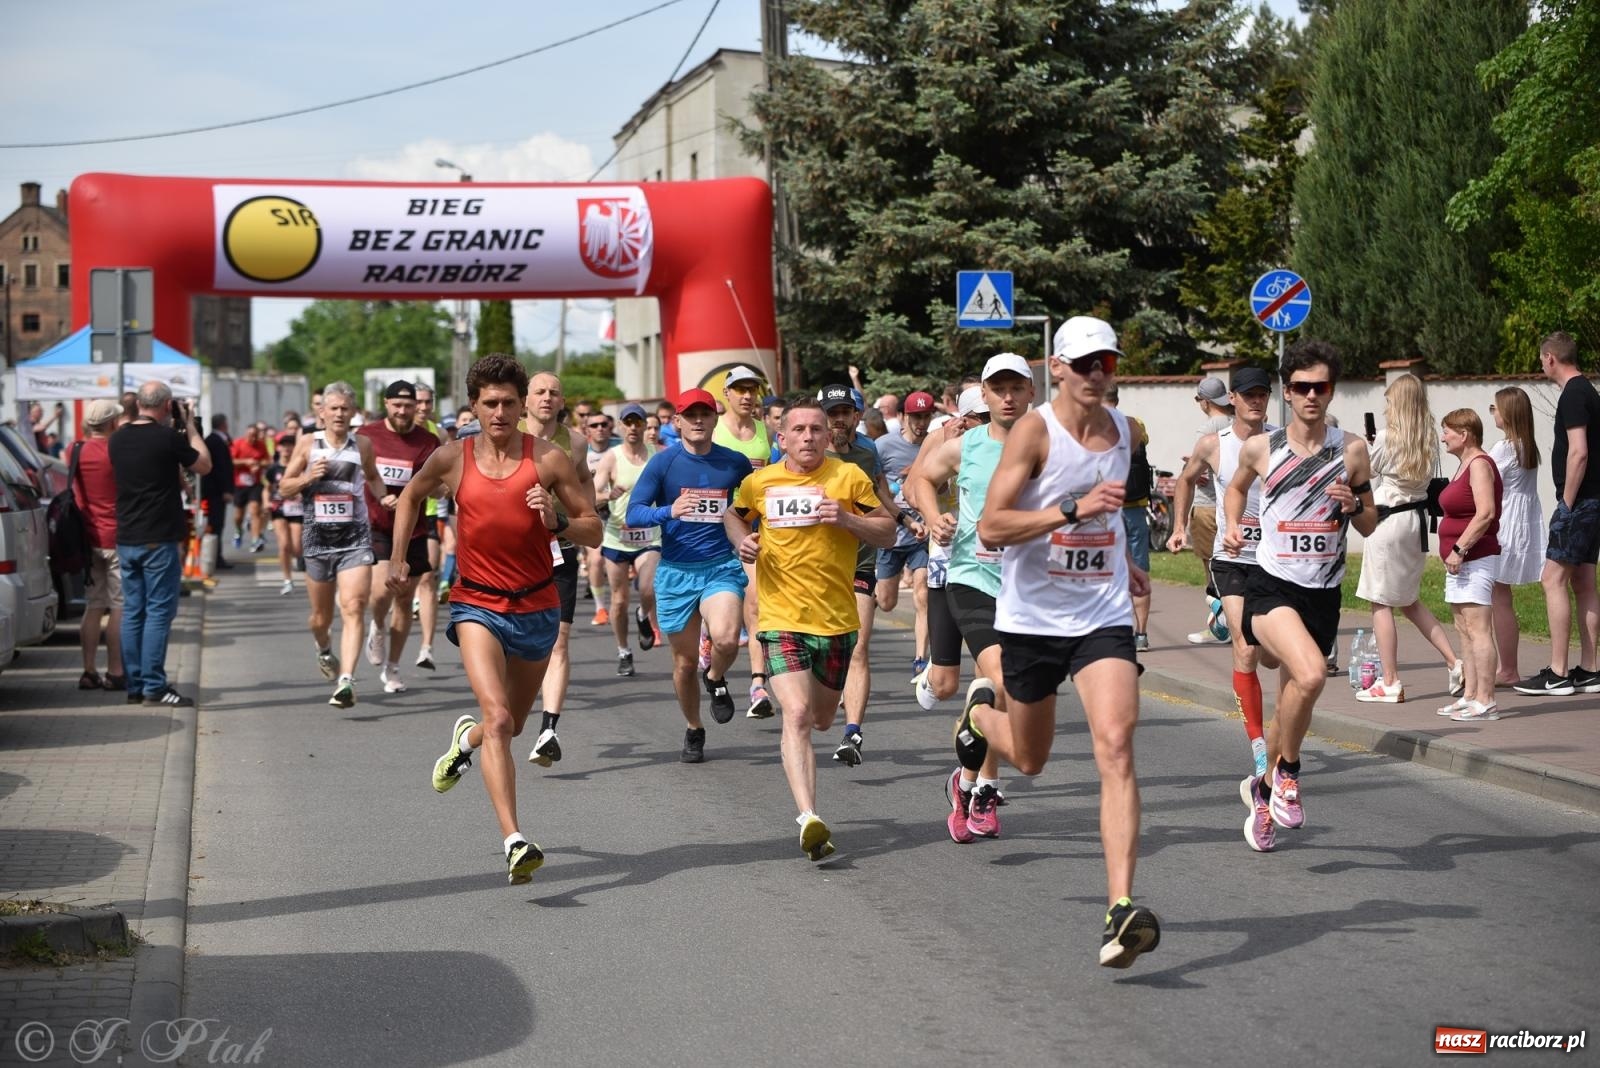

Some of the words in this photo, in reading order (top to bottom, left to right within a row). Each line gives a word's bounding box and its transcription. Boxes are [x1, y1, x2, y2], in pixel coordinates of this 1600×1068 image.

[407, 198, 485, 216] BIEG
[348, 229, 416, 252] BEZ
[422, 228, 544, 252] GRANIC
[362, 258, 528, 284] RACIBÓRZ
[827, 388, 846, 399] ciele
[383, 466, 404, 480] 217
[322, 503, 346, 515] 135
[776, 497, 812, 516] 143
[628, 530, 646, 542] 121
[1289, 534, 1327, 553] 136
[1064, 549, 1105, 571] 184
